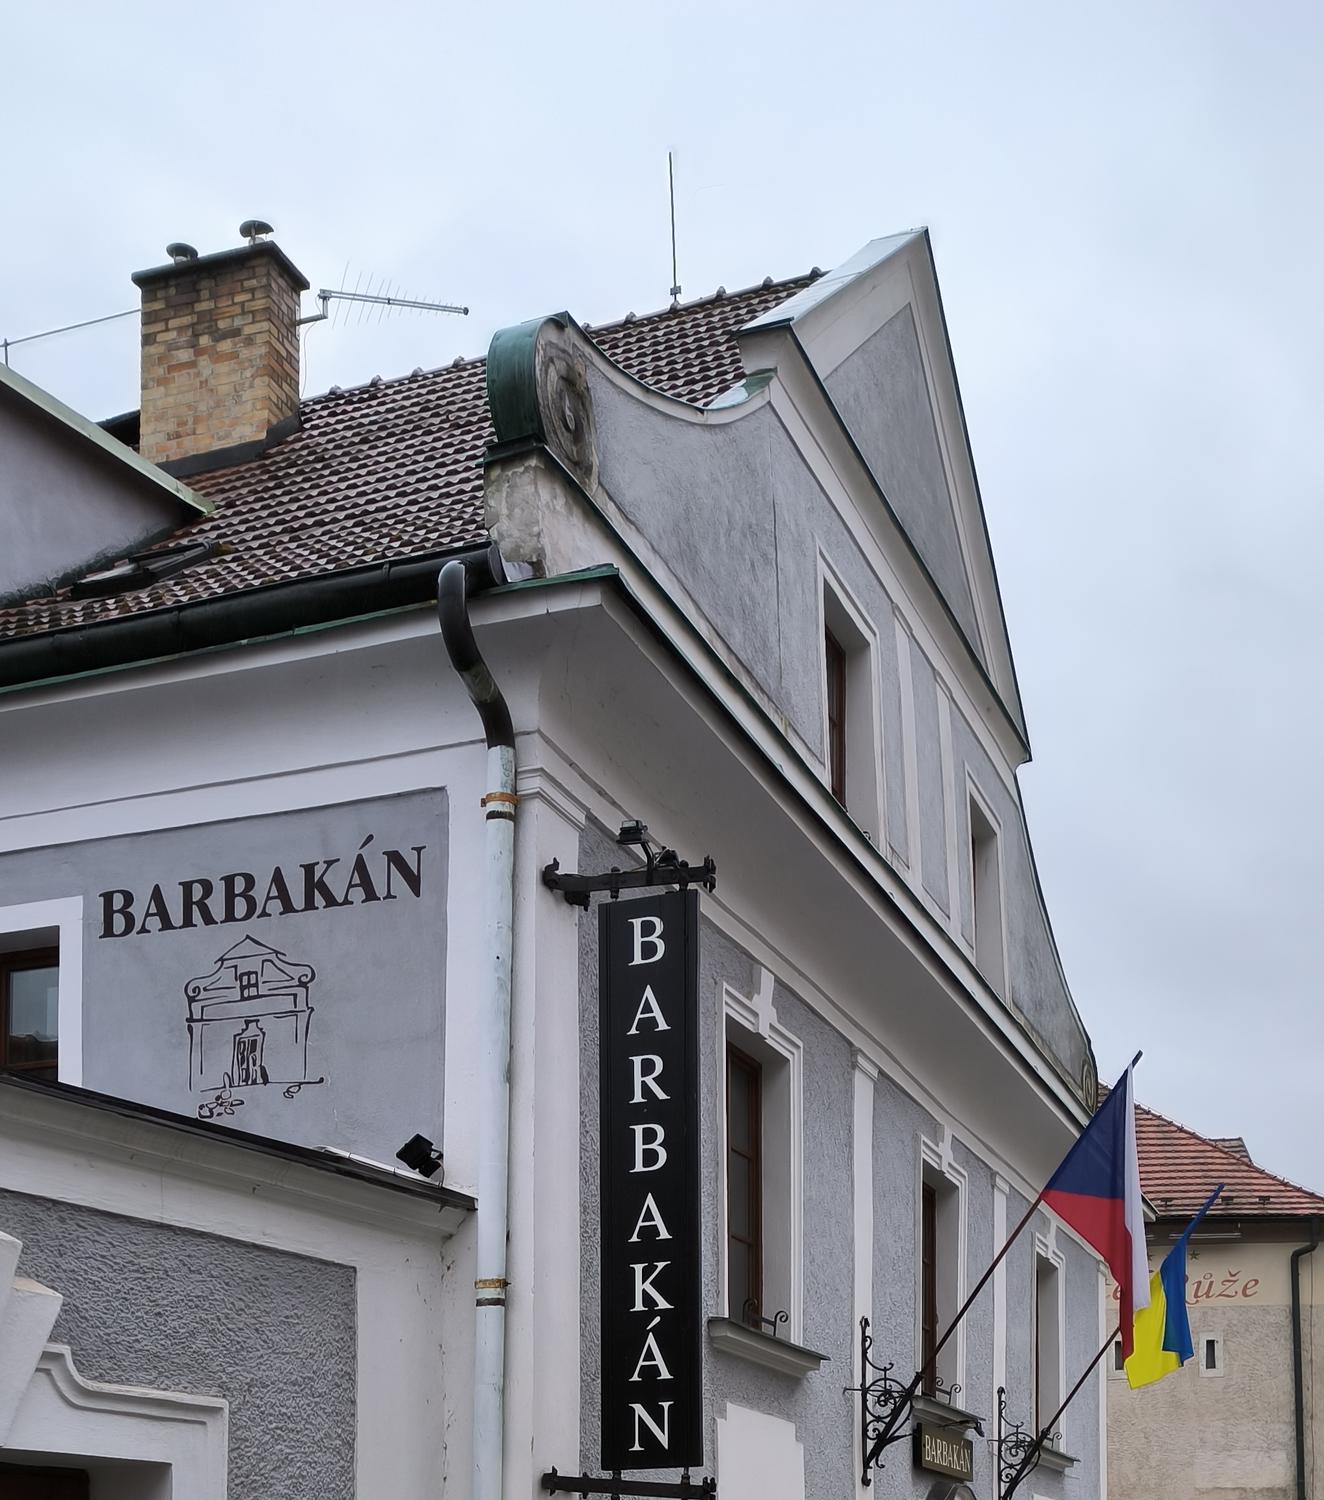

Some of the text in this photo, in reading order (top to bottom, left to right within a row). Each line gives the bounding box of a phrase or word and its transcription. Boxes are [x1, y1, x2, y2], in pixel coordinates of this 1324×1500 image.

[98, 834, 426, 939] BARBAKÁN
[626, 914, 674, 1453] BARBAKÁN
[925, 1434, 971, 1474] BARBAKÁN
